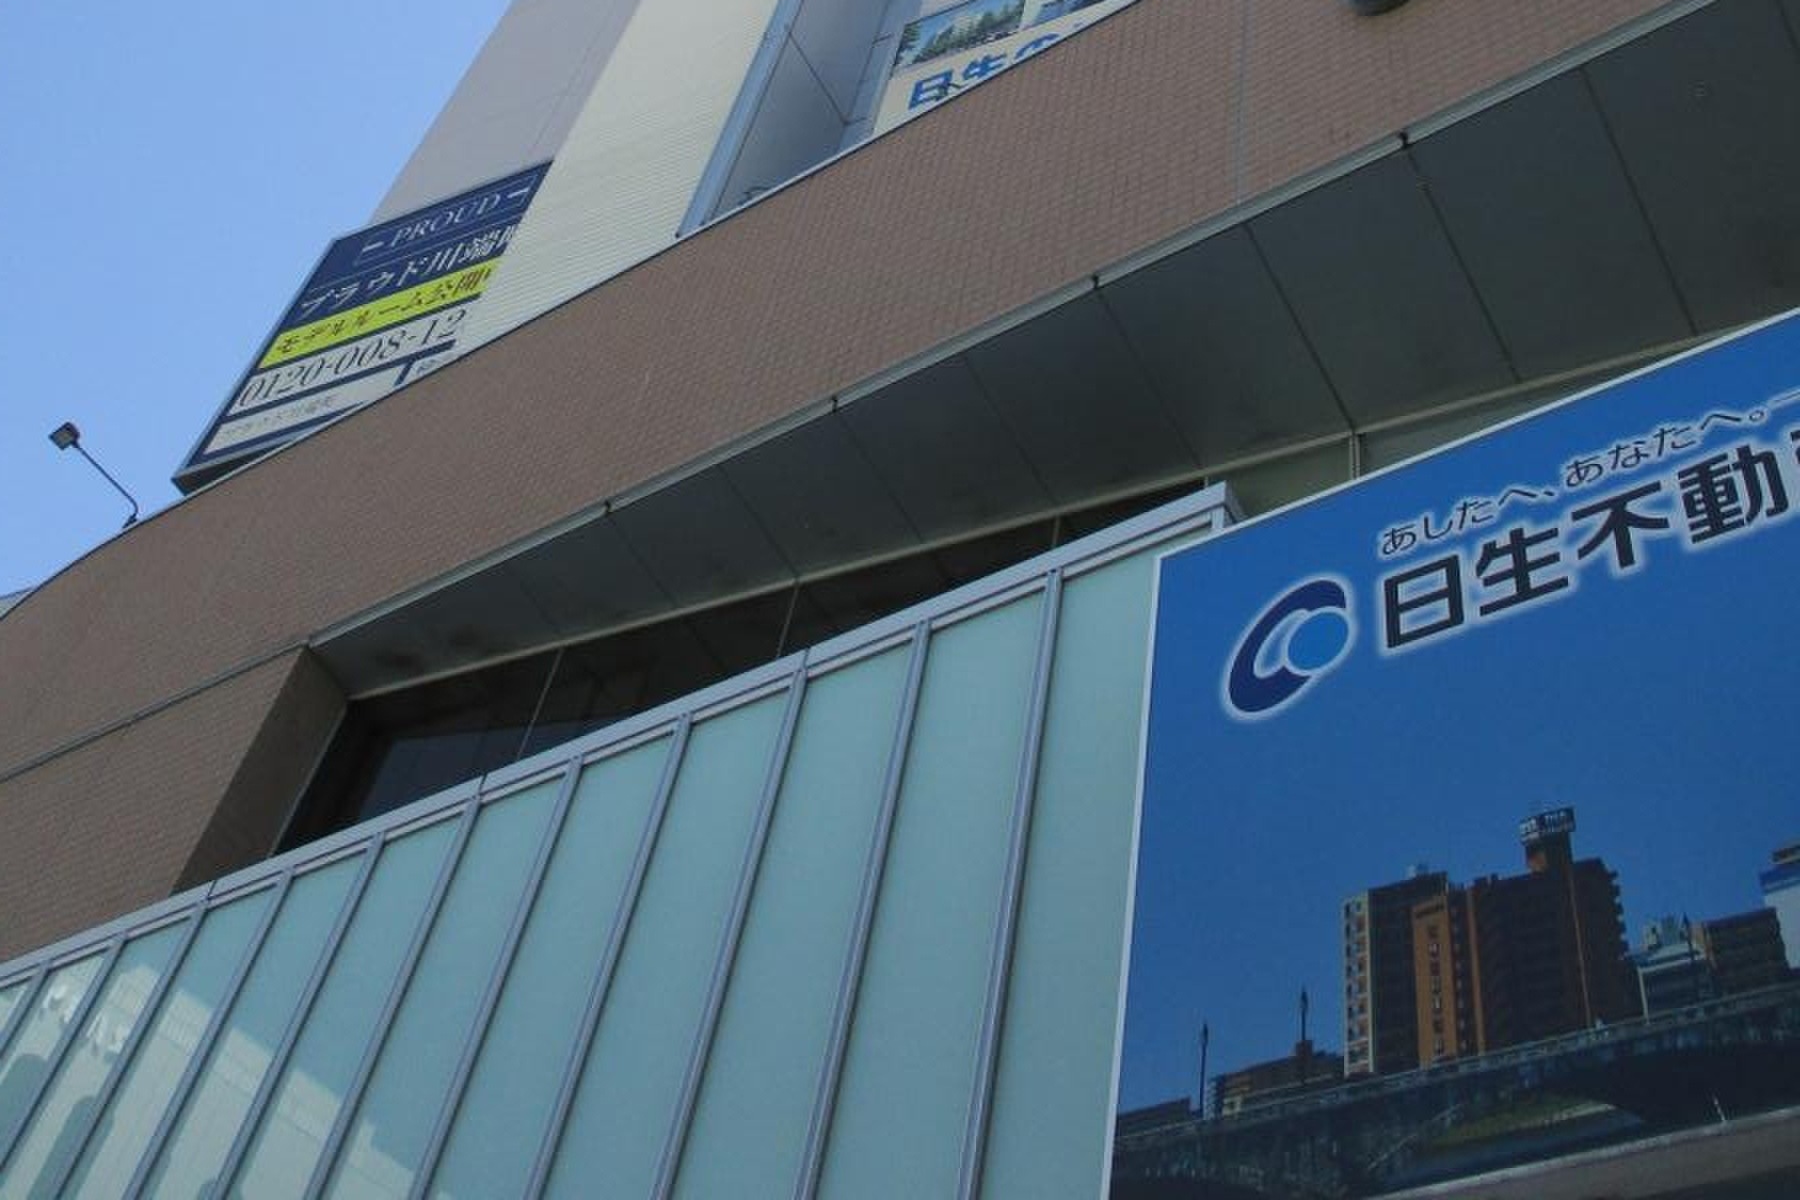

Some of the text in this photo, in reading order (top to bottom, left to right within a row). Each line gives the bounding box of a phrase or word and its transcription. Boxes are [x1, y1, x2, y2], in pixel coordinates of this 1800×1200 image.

[391, 191, 500, 248] PROUD
[276, 266, 491, 355] モデルルーム公開
[1384, 429, 1800, 649] 日生不動
